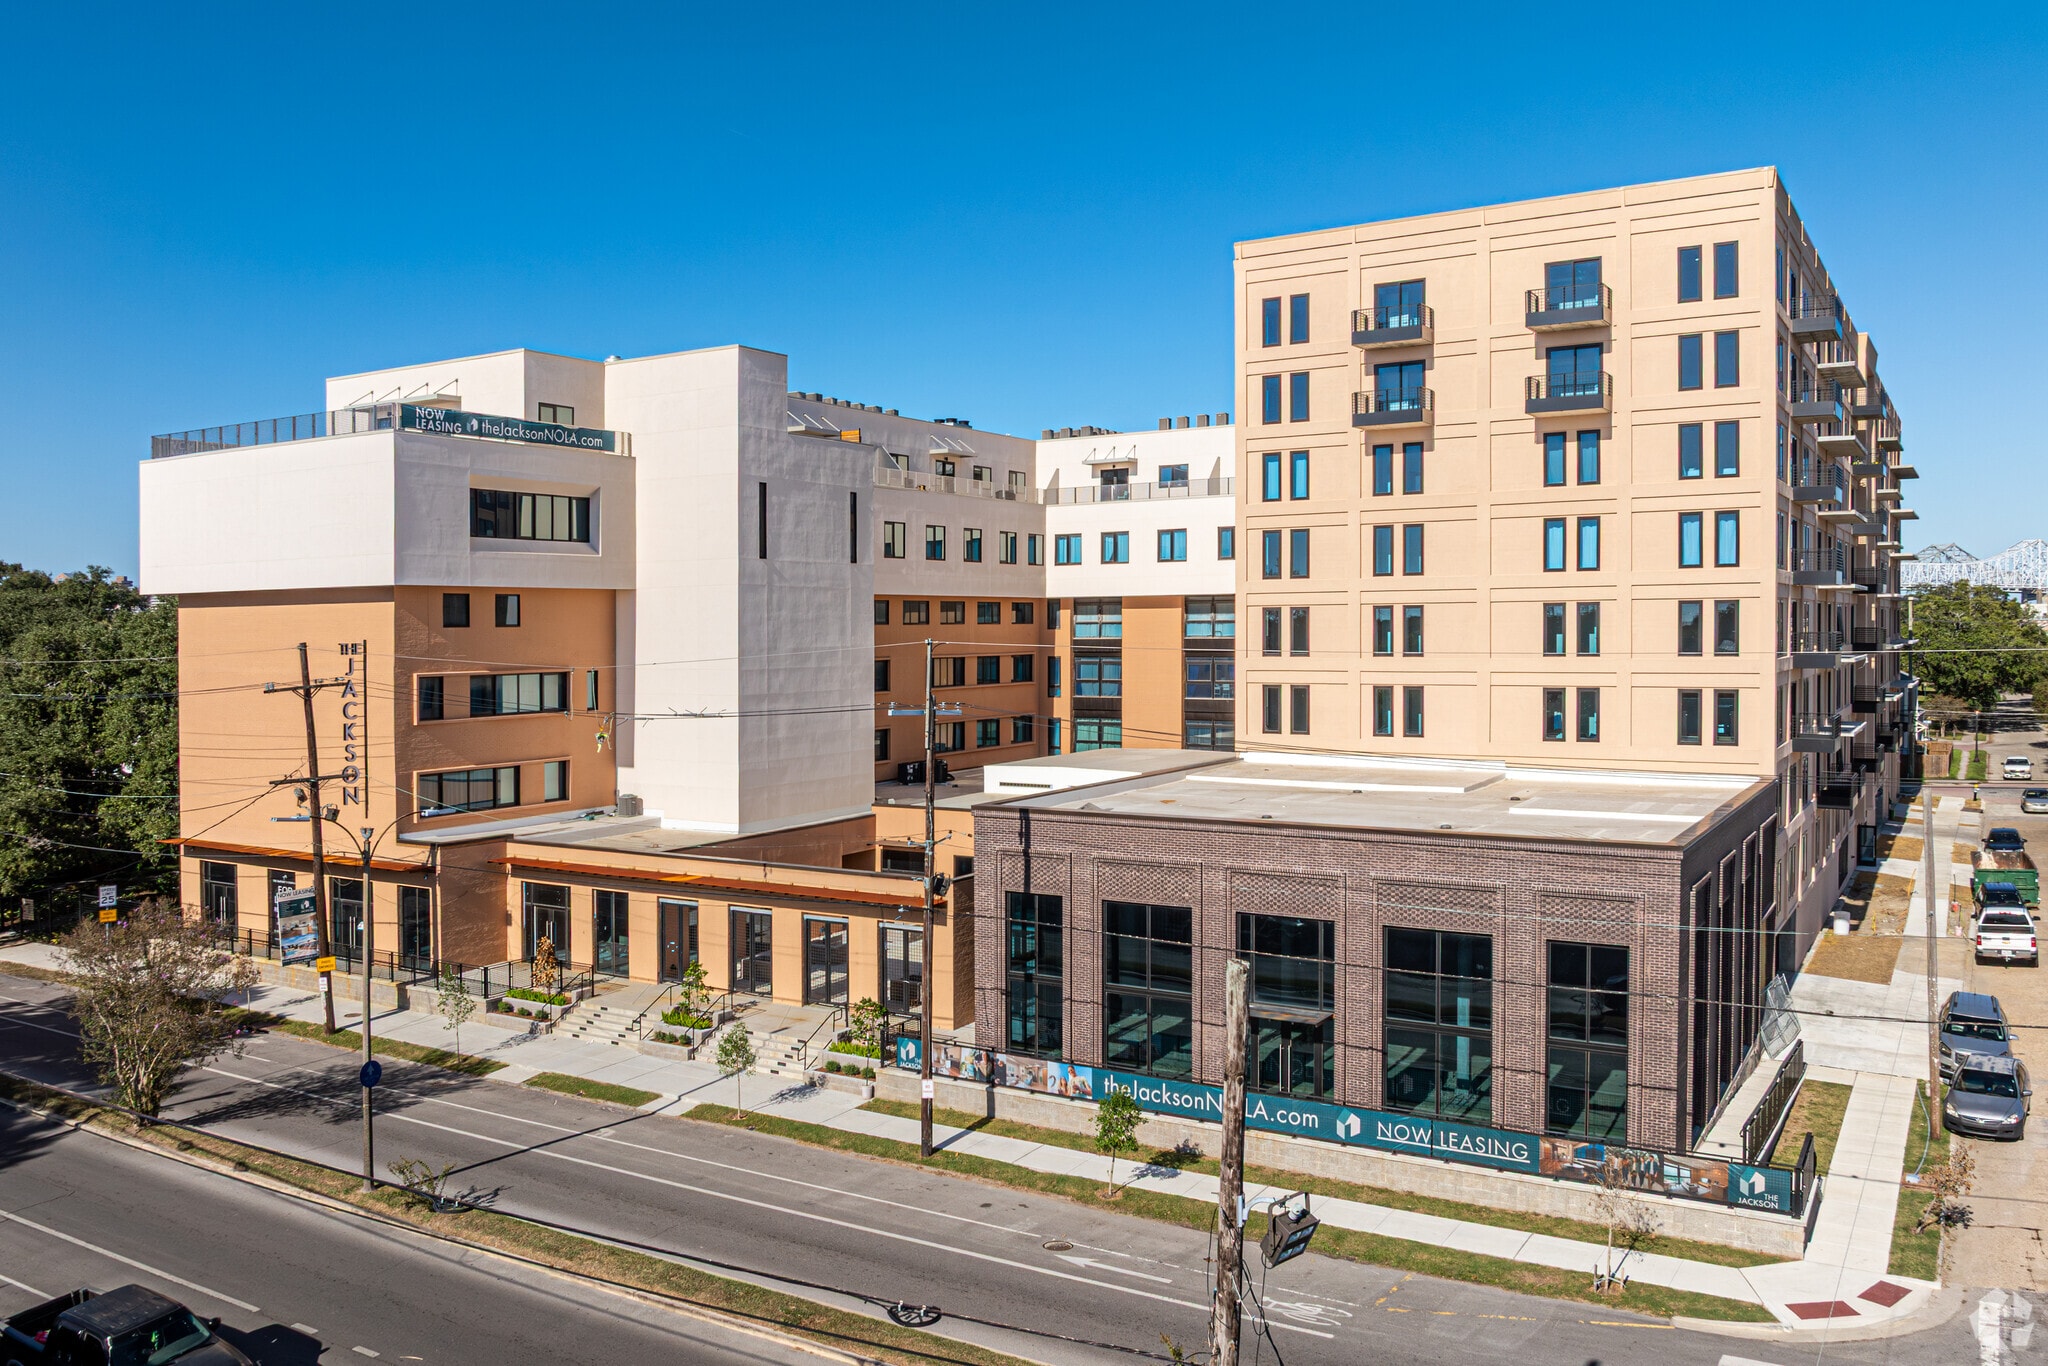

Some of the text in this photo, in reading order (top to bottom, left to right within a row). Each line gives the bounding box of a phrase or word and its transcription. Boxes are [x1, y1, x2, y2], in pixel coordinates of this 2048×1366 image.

[415, 406, 446, 421] NOW
[415, 418, 462, 434] LEASING
[481, 419, 603, 447] theJacksonNOLA.com
[338, 643, 362, 655] THE
[341, 657, 360, 806] JACKSON
[101, 896, 115, 905] 25
[1104, 1074, 1319, 1129] theJacksonNLA.com
[1377, 1120, 1529, 1160] NOW LEASING
[1738, 1197, 1778, 1209] JACKSON
[1764, 1193, 1778, 1201] THE
